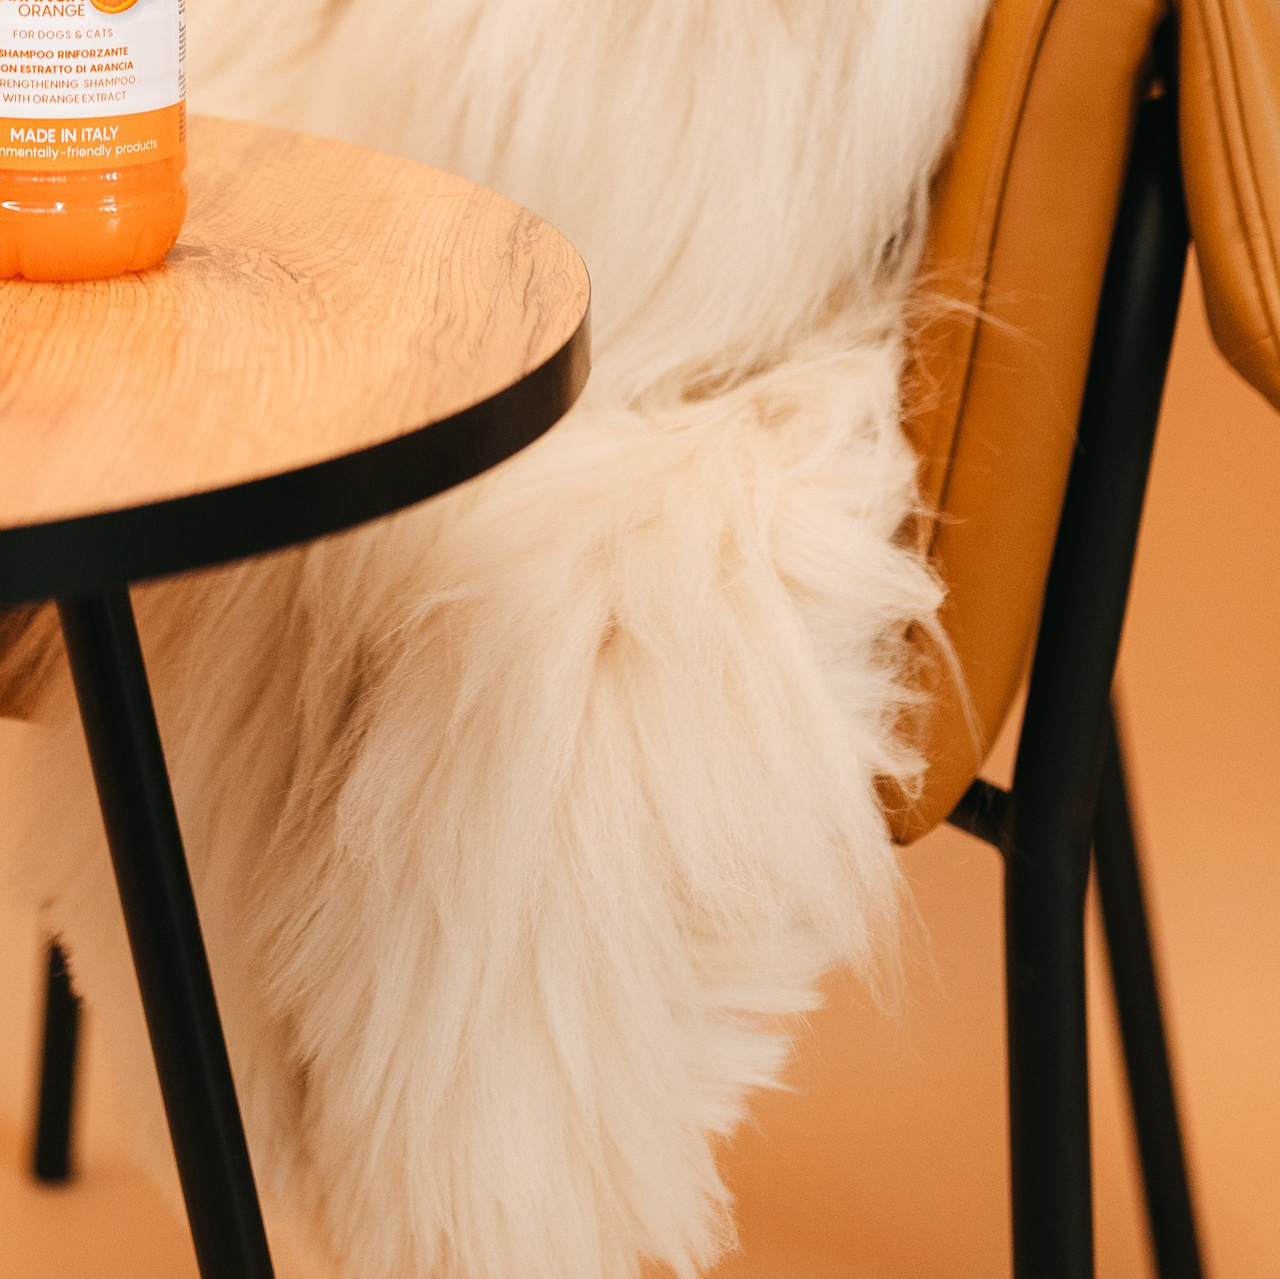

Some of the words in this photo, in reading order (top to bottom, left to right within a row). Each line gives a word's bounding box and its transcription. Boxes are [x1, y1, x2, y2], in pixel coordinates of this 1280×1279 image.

[19, 4, 85, 17] ORANGE
[13, 30, 36, 39] FOR
[38, 30, 71, 39] DOGS
[76, 29, 82, 38] &
[86, 29, 114, 38] CATS
[0, 49, 54, 59] SHAMPOO
[58, 47, 128, 59] RINFORZANTE
[20, 64, 72, 74] ESTRATTO
[76, 64, 86, 73] DI
[90, 61, 133, 73] ARANCIA
[84, 76, 136, 88] SHAMPOO
[3, 93, 30, 103] WITH
[33, 93, 79, 104] ORANGE
[82, 91, 126, 103] EXTRACT
[10, 127, 56, 143] MADE
[61, 128, 76, 142] IN
[82, 126, 119, 141] ITALY
[115, 139, 157, 155] products
